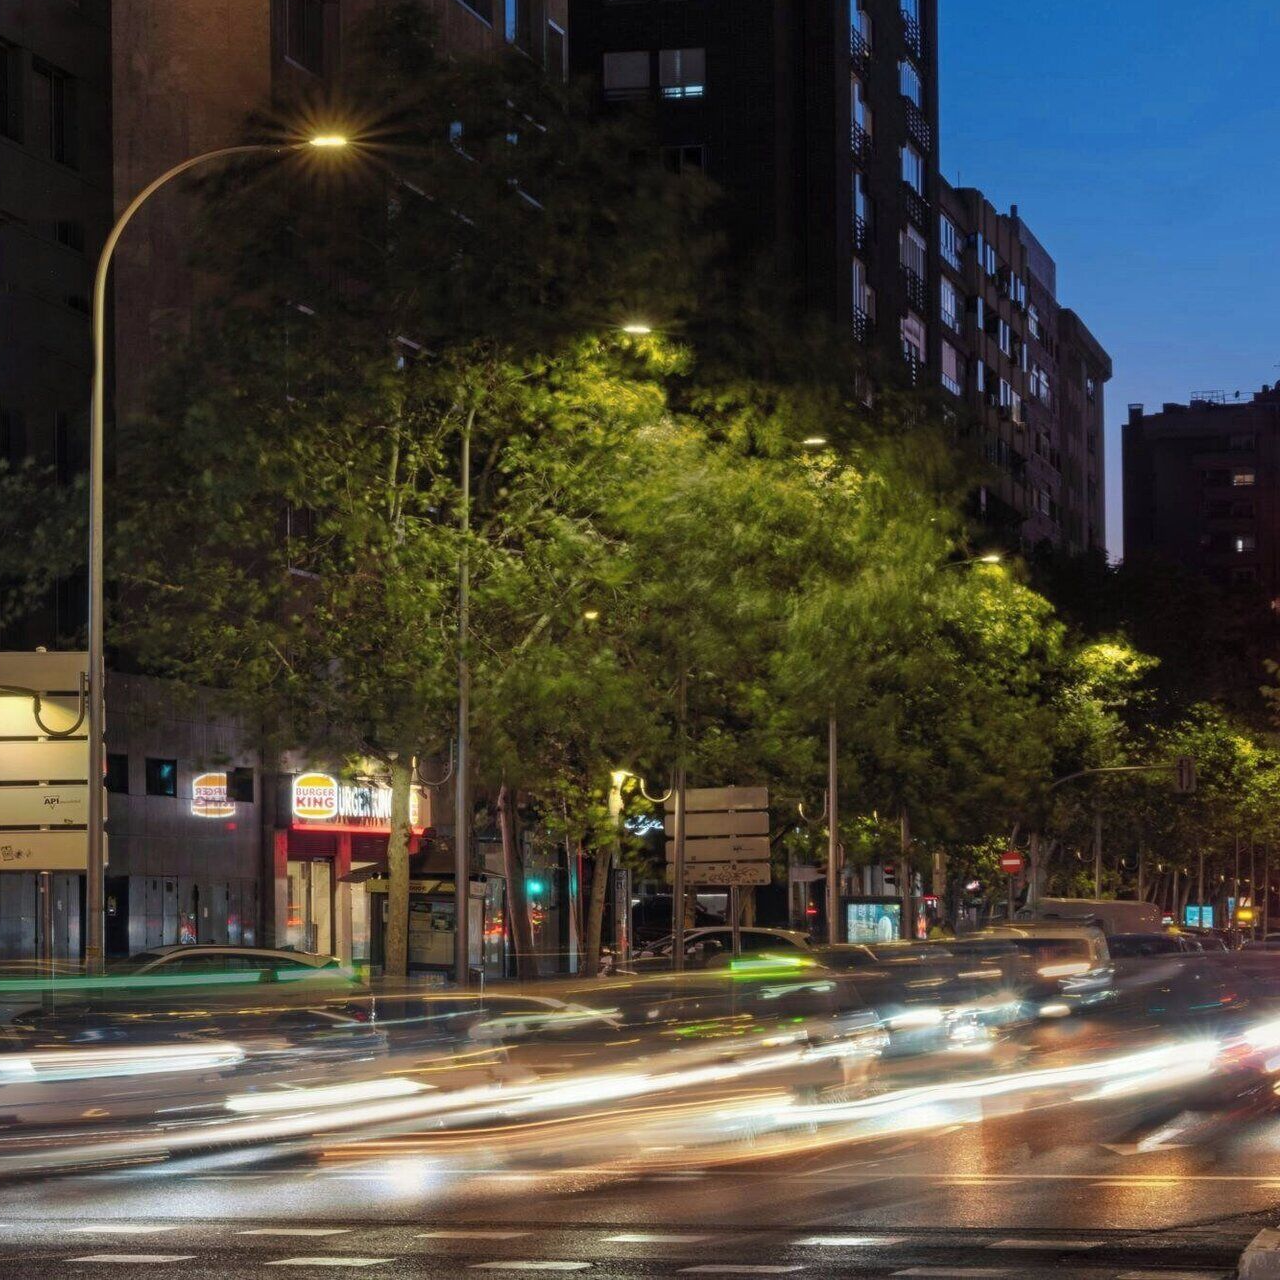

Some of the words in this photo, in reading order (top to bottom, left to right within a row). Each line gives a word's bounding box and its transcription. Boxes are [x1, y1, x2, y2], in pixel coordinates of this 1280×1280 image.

[296, 787, 335, 797] BURGER
[44, 797, 60, 805] API
[296, 796, 335, 808] KING
